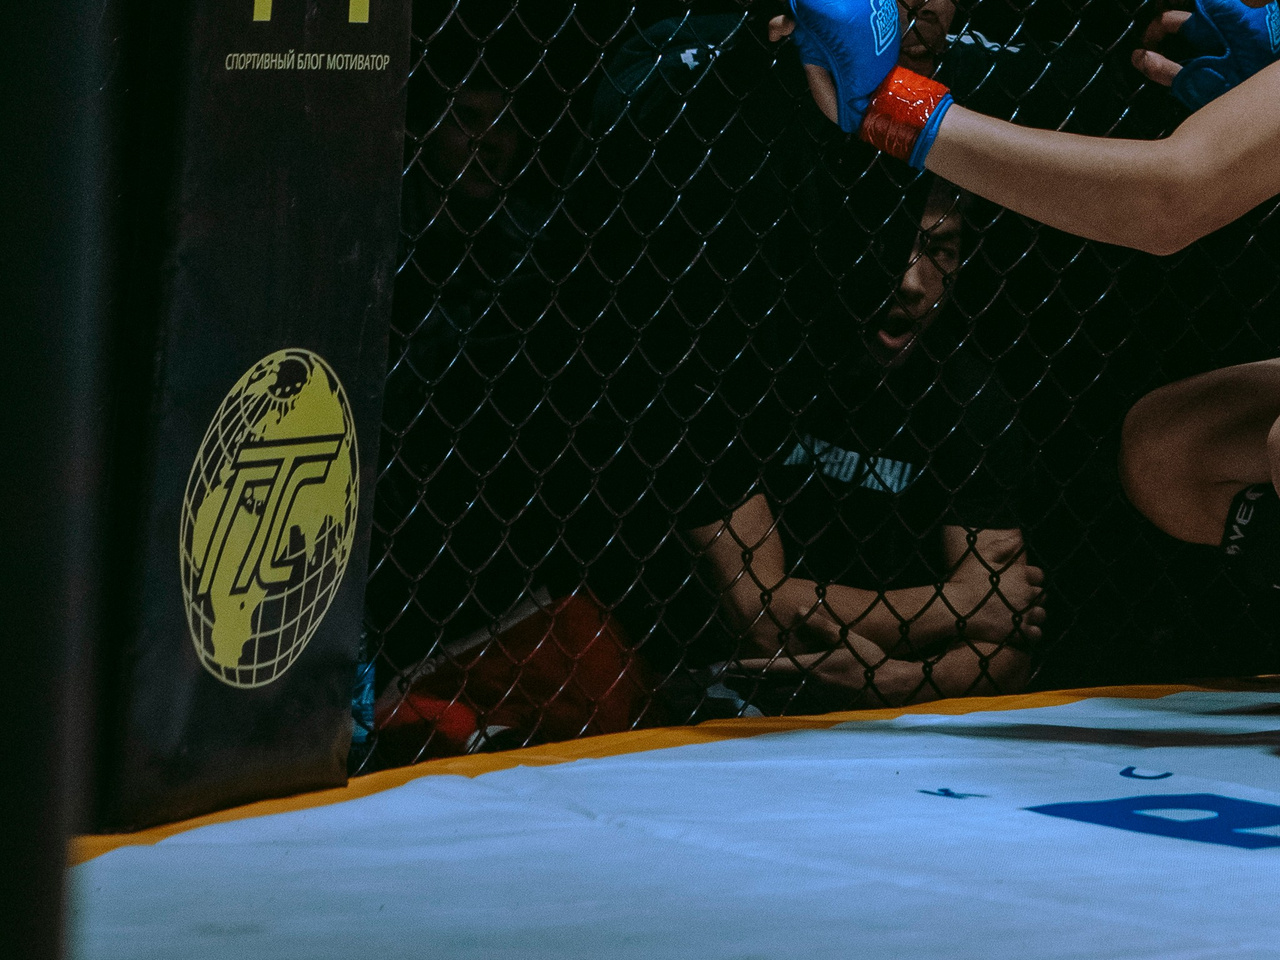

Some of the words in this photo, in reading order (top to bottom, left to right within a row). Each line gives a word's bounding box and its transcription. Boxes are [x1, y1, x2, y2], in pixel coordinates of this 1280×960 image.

[225, 49, 296, 71] СПОРТИВНЫЙ
[297, 53, 325, 70] БЛОГ
[326, 53, 390, 71] МОТИВАТОР
